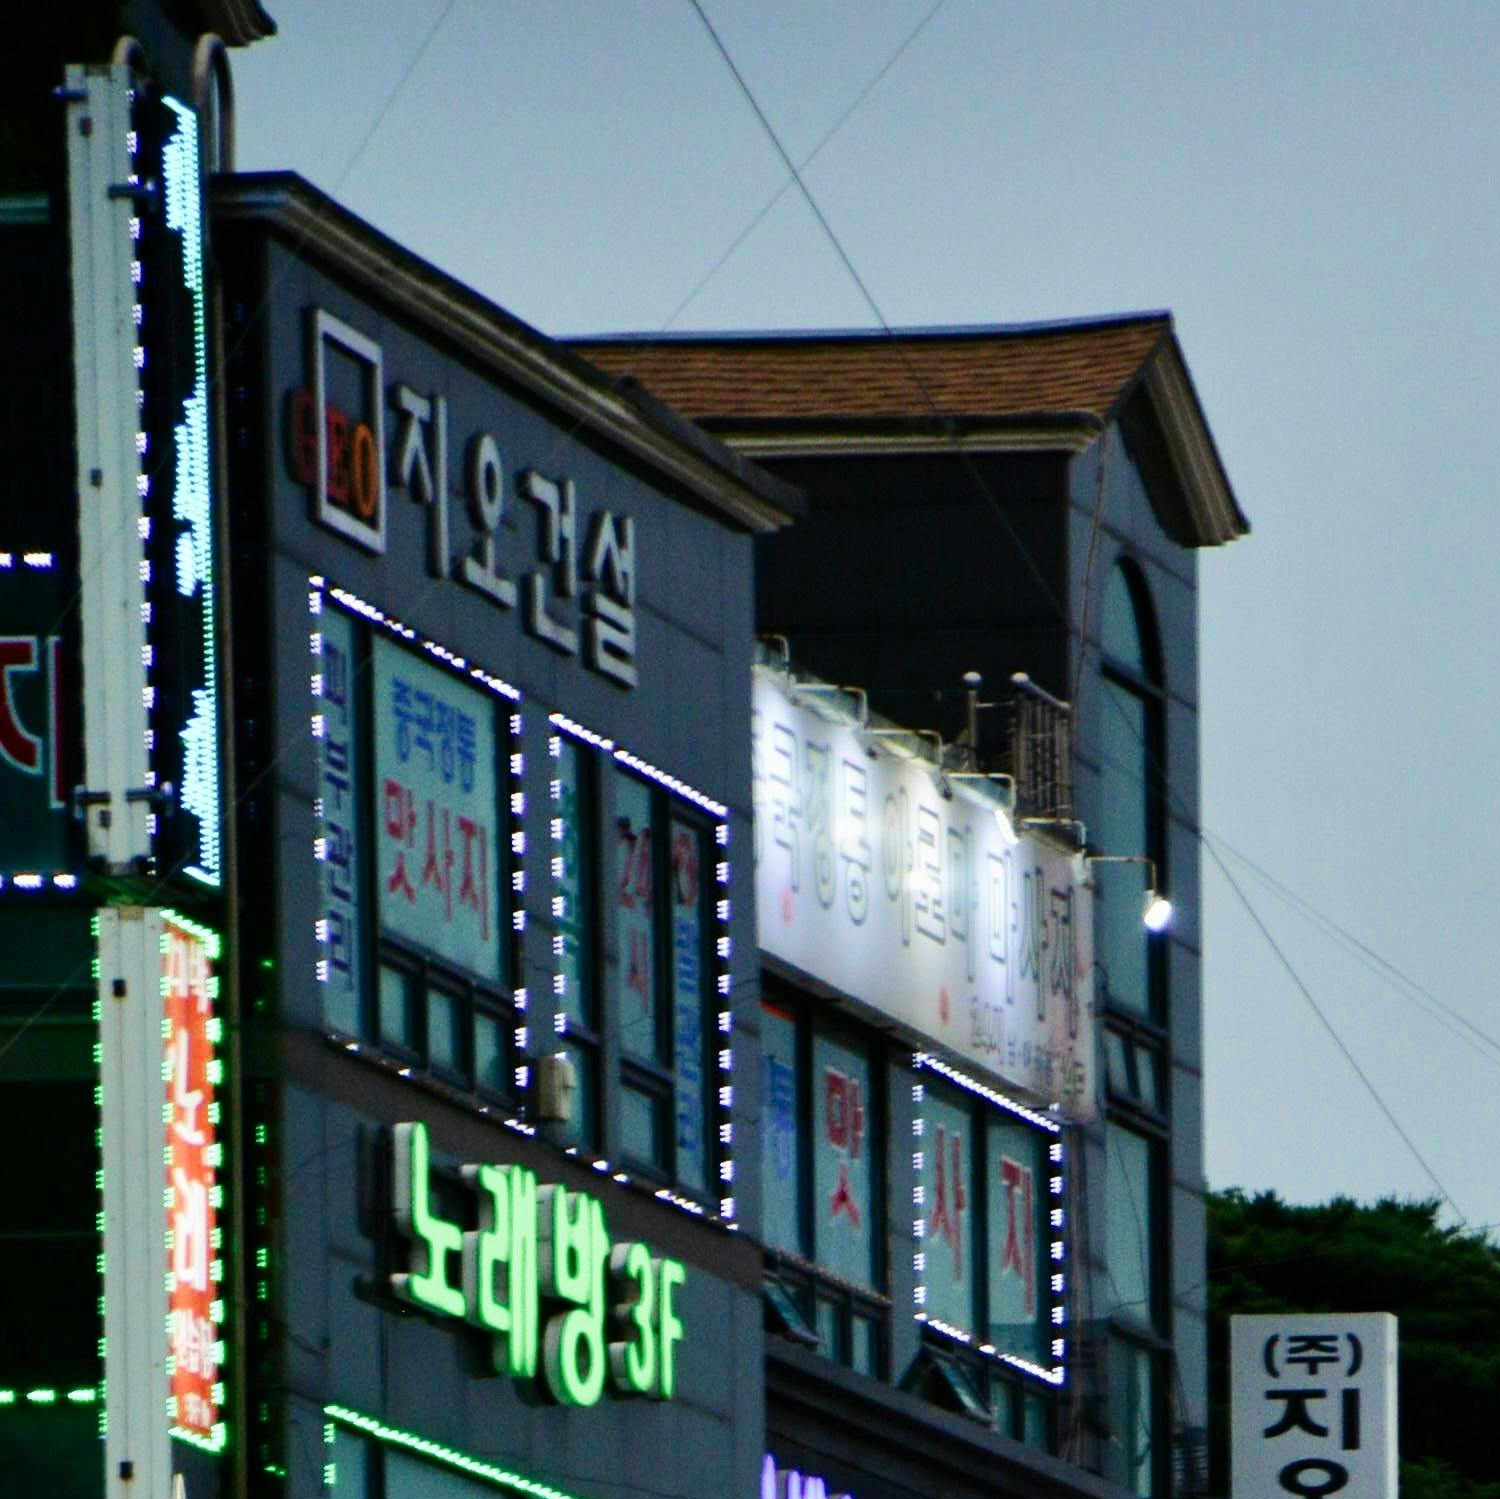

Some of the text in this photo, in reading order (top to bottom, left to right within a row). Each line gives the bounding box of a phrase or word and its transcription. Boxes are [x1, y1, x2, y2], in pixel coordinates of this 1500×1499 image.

[397, 383, 638, 689] 지오건설
[382, 777, 490, 943] 맛사지
[752, 710, 873, 926] 국정통
[884, 787, 974, 983] 아로마
[986, 850, 1079, 1041] 마사지
[398, 1121, 687, 1407] 노래방 3F
